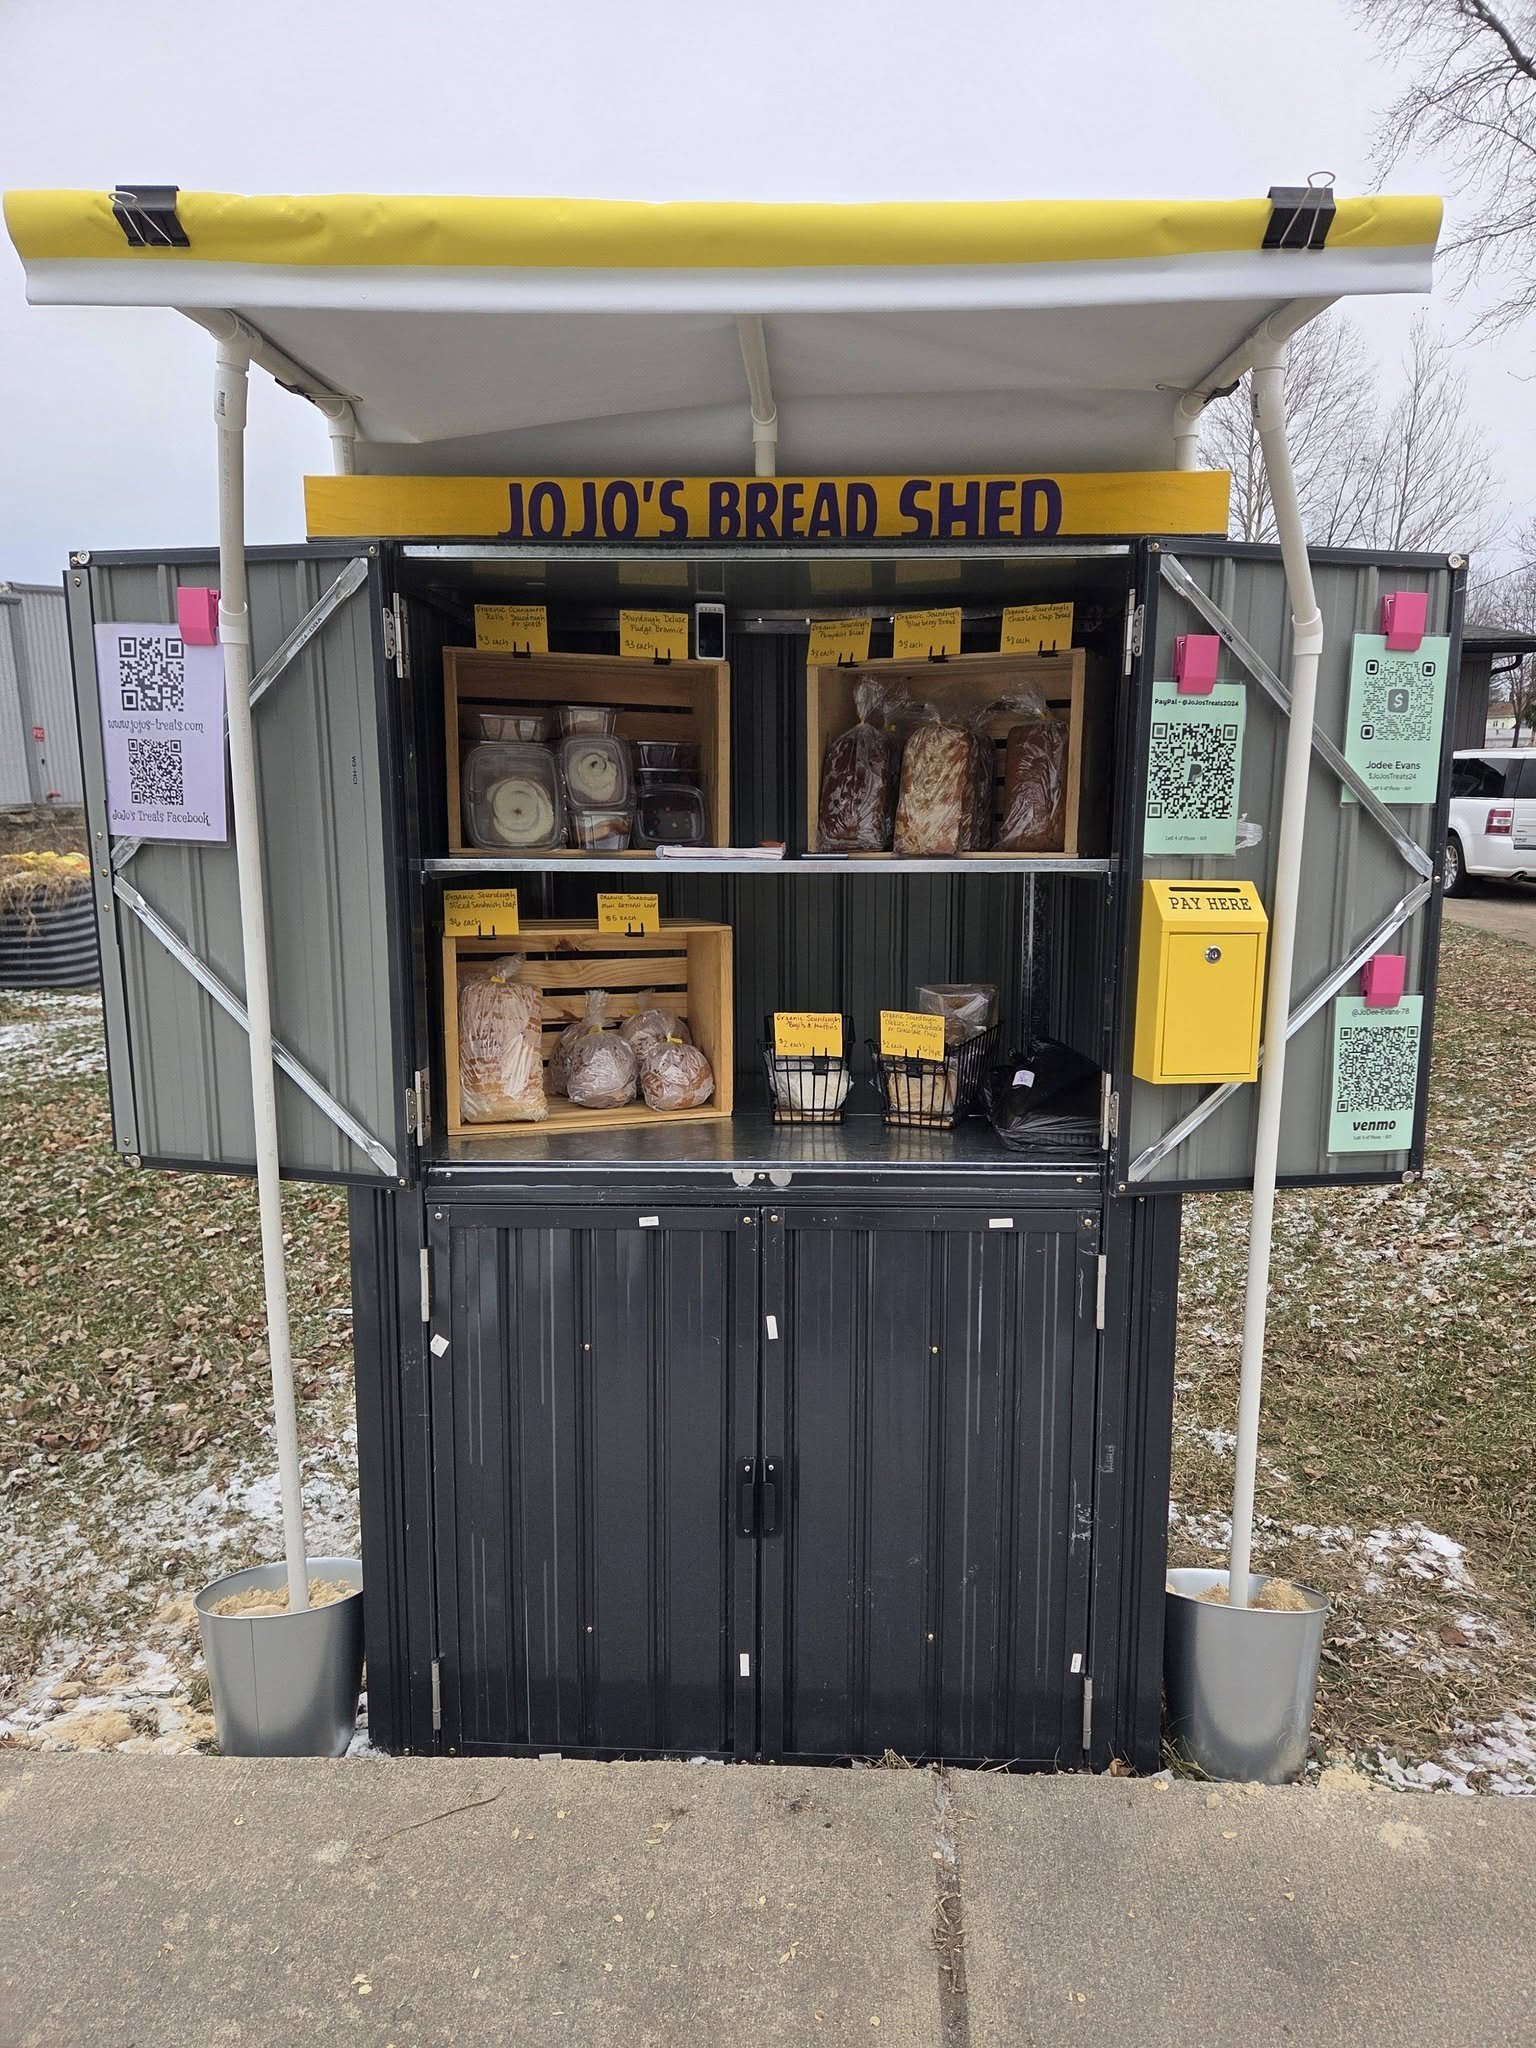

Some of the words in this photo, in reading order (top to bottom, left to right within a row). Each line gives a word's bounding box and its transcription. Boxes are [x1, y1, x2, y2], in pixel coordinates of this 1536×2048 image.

[498, 480, 688, 538] JOJO'S
[709, 482, 877, 537] BREAD
[900, 479, 1062, 536] SHED
[622, 613, 660, 626] Sourdough
[664, 615, 686, 623] Deluxe
[630, 624, 652, 635] Fudge
[655, 625, 685, 634] Brownie
[478, 634, 490, 645] $3
[625, 640, 635, 648] $3
[899, 640, 908, 649] $8
[1154, 698, 1178, 706] PayPal
[1182, 699, 1239, 707] @JoJosTreats2024
[107, 718, 204, 734] www.jojos-treats.com
[1366, 761, 1393, 770] Jodee
[1395, 761, 1421, 770] Evans
[1368, 772, 1417, 780] $JoJosTreats24
[137, 810, 164, 823] Treats
[167, 812, 211, 826] Facebook
[445, 893, 475, 901] Organic
[478, 891, 516, 900] Sourdough
[502, 901, 516, 909] Loaf
[1168, 897, 1201, 909] PAY
[1206, 898, 1252, 910] HERE
[449, 918, 460, 927] $6
[464, 918, 481, 926] each
[806, 1015, 841, 1024] Sourdough
[779, 1038, 787, 1048] $2
[1353, 1120, 1396, 1132] venmo
